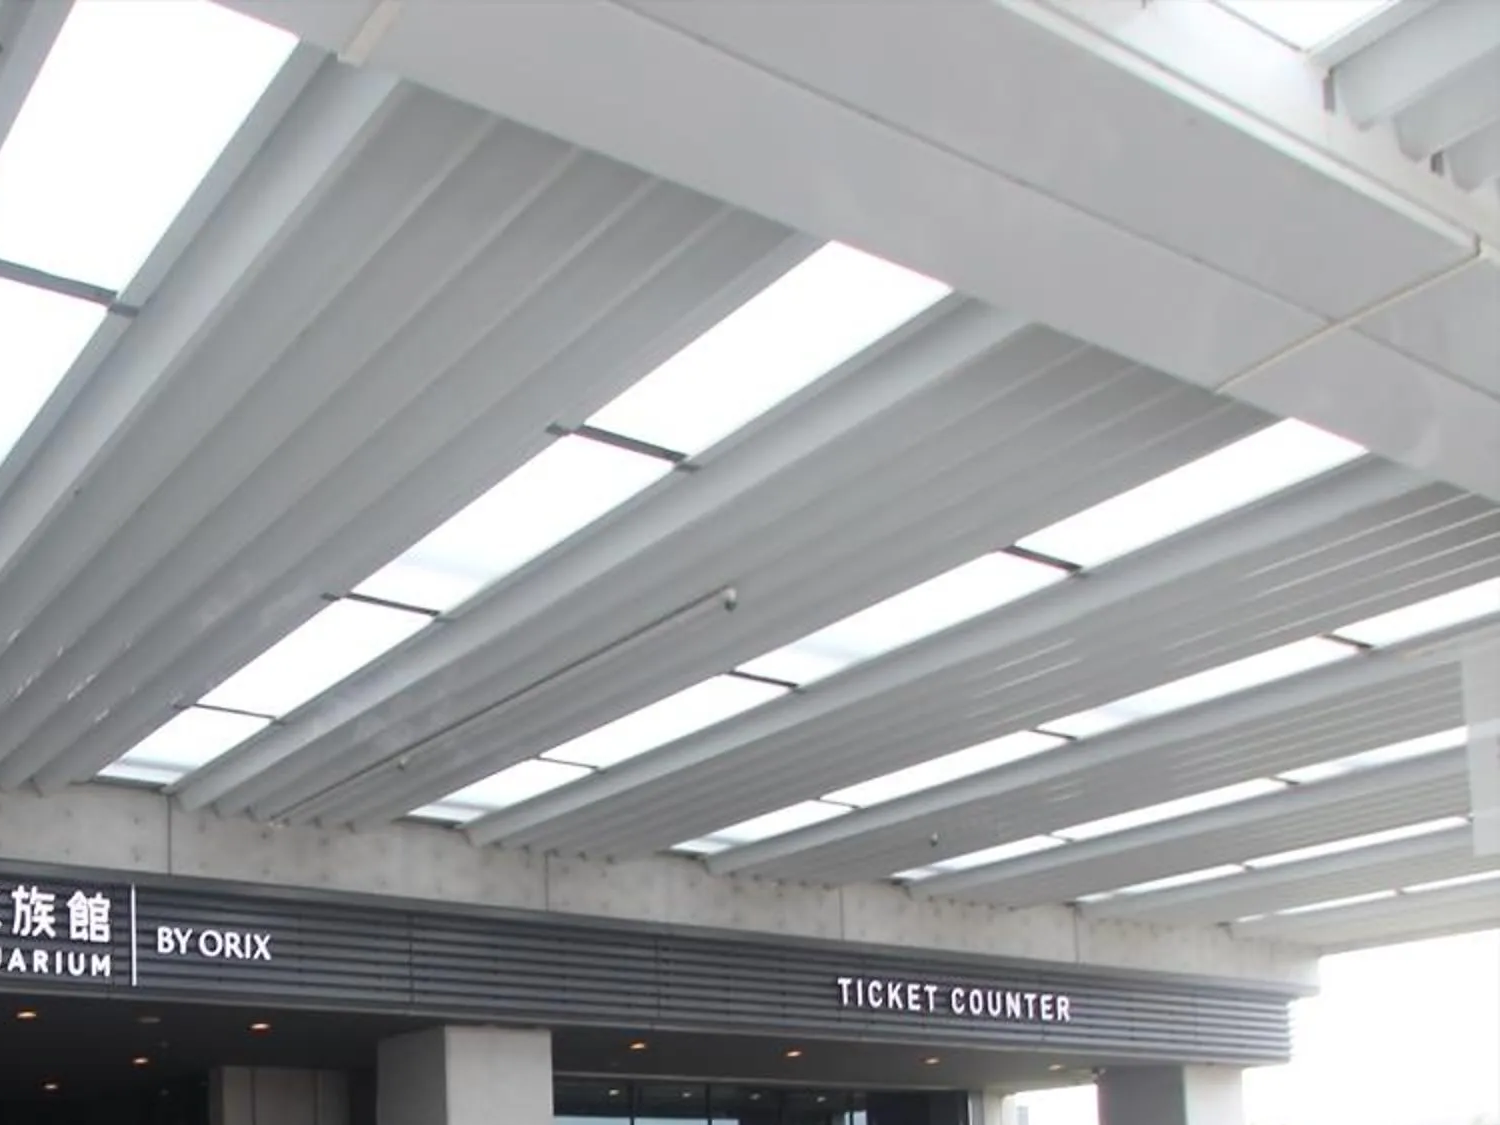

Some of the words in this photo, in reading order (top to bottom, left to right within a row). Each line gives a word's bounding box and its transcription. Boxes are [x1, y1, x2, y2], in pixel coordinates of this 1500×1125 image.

[157, 926, 193, 955] BY
[198, 929, 271, 960] ORIX
[837, 977, 937, 1012] TICKET
[951, 987, 1071, 1022] COUNTER
